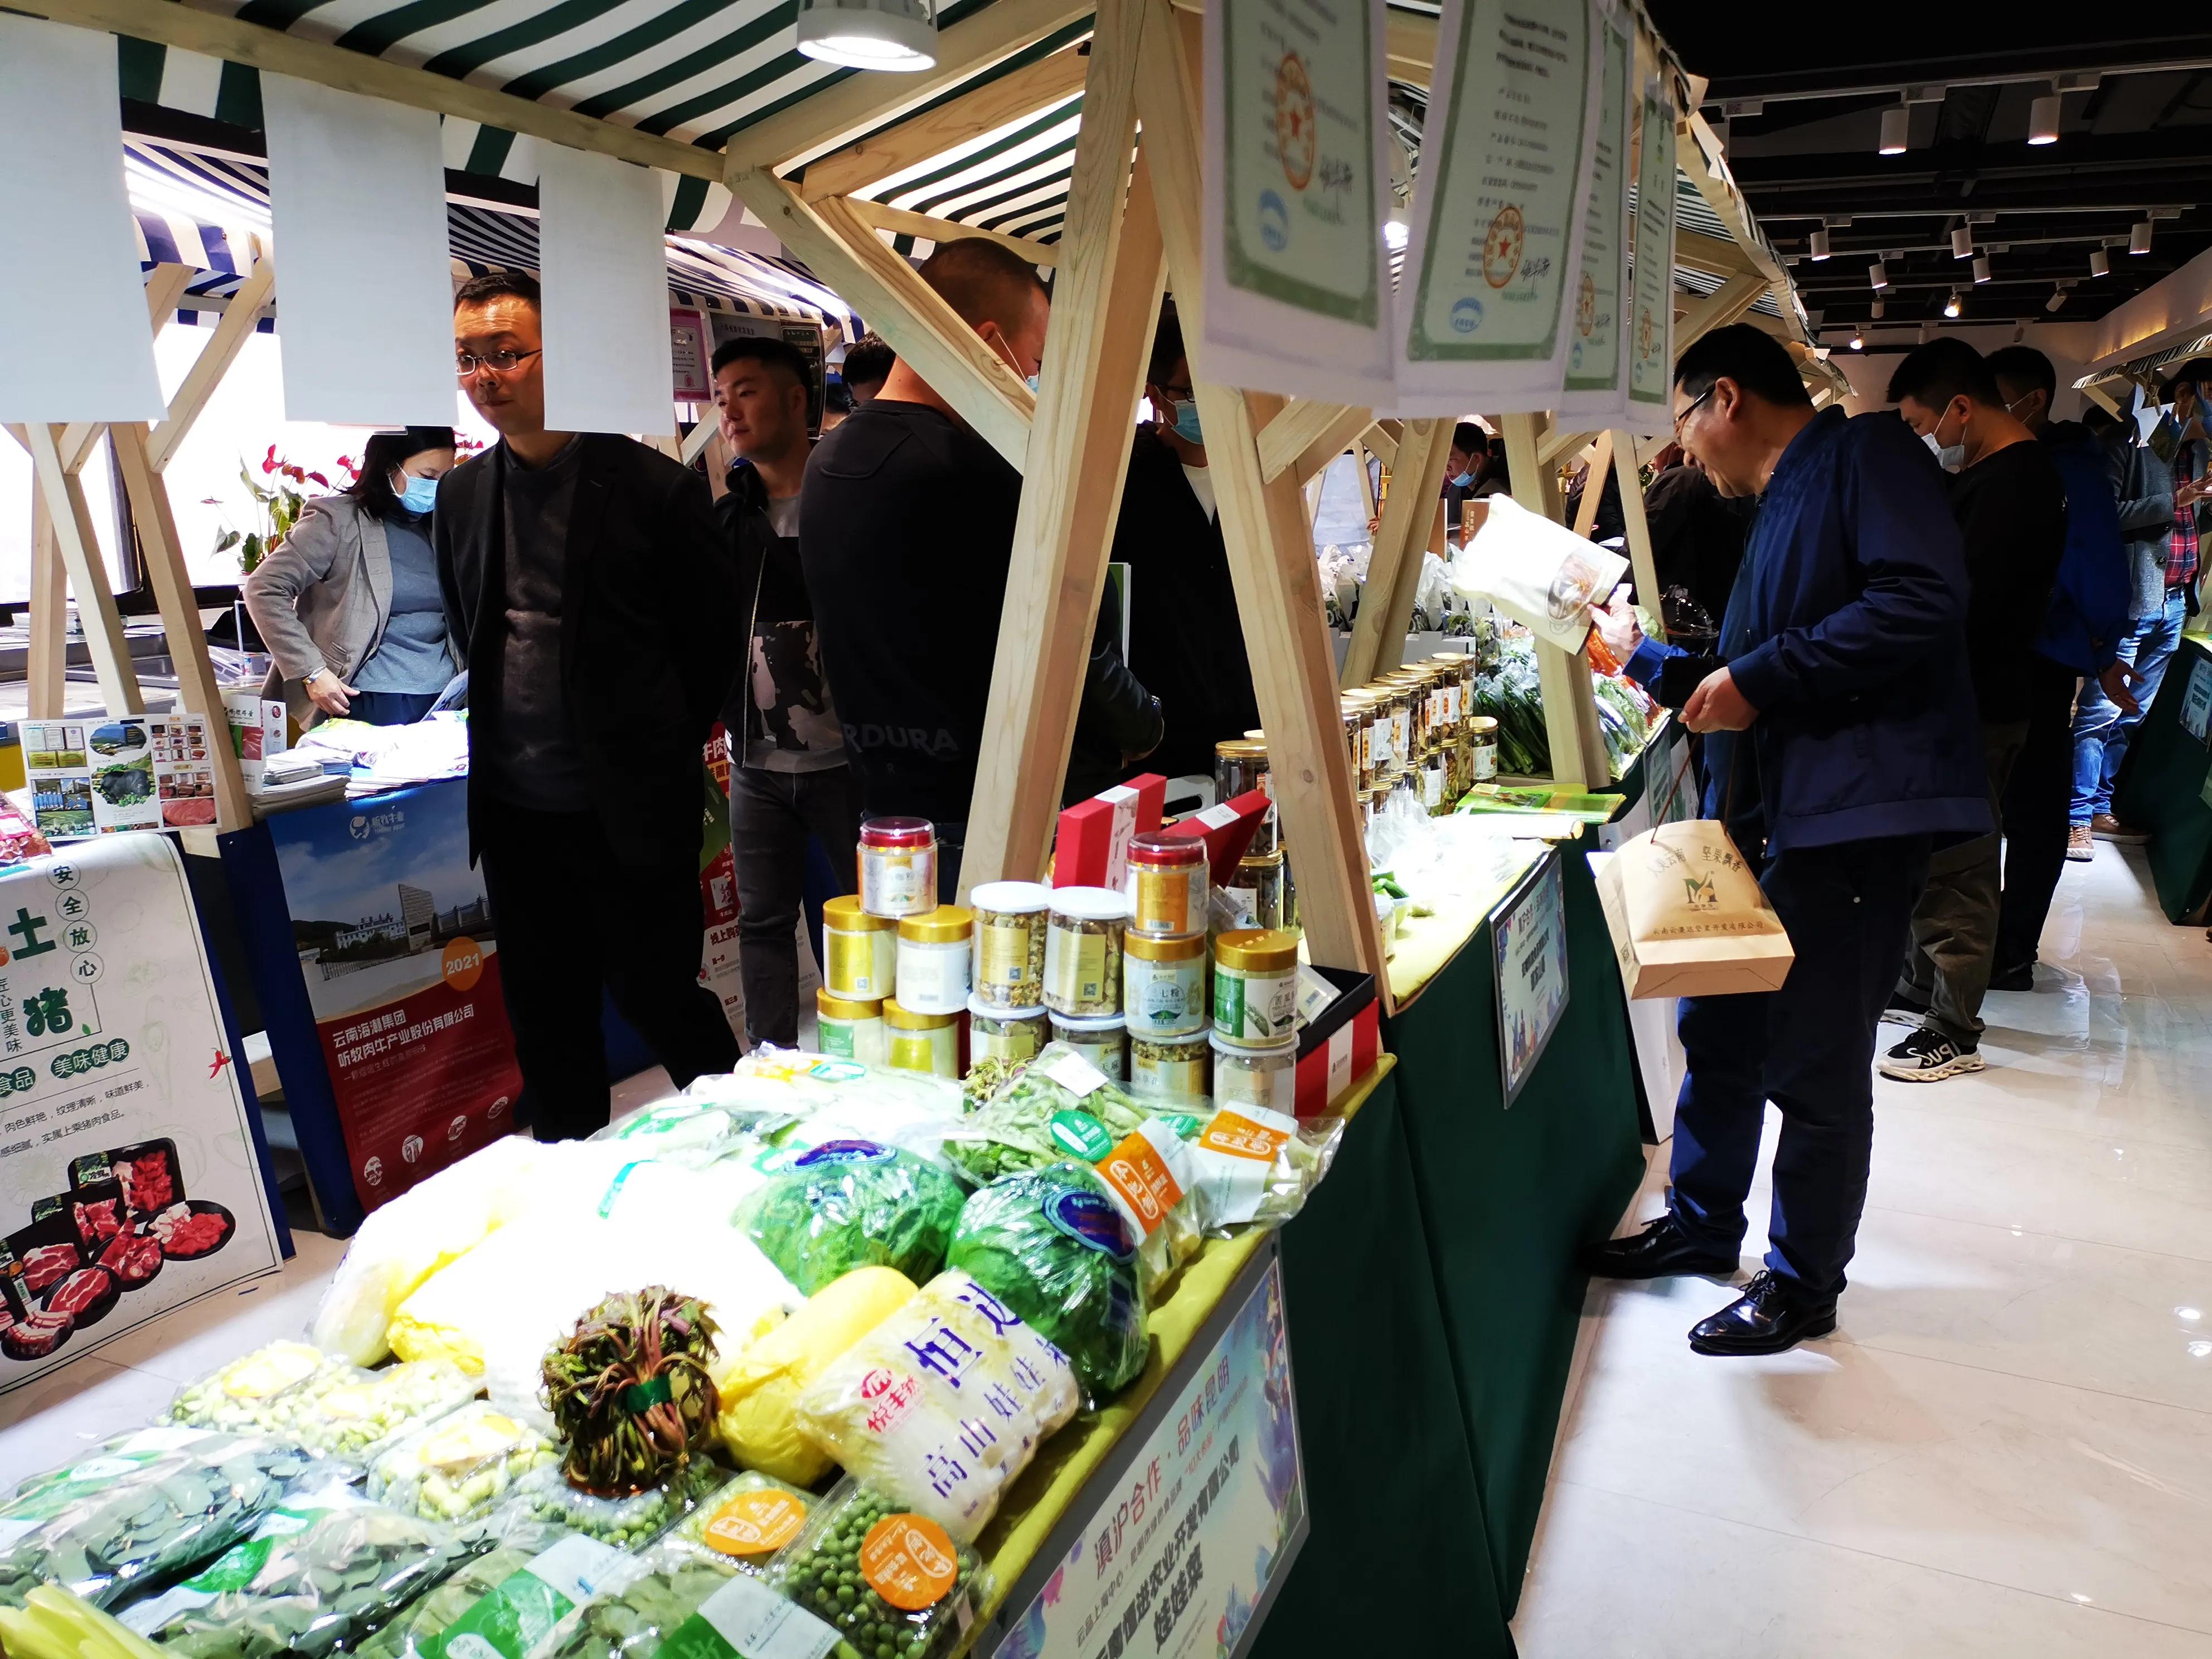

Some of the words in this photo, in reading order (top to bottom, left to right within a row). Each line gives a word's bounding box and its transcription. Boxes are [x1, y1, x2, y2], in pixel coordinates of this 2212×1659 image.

[53, 865, 98, 978] 安全放心
[445, 953, 480, 976] 2021
[332, 1009, 406, 1049] 云南海潮集团
[54, 1041, 128, 1078] 美味健康
[1154, 1542, 1204, 1655] 娃娃菜
